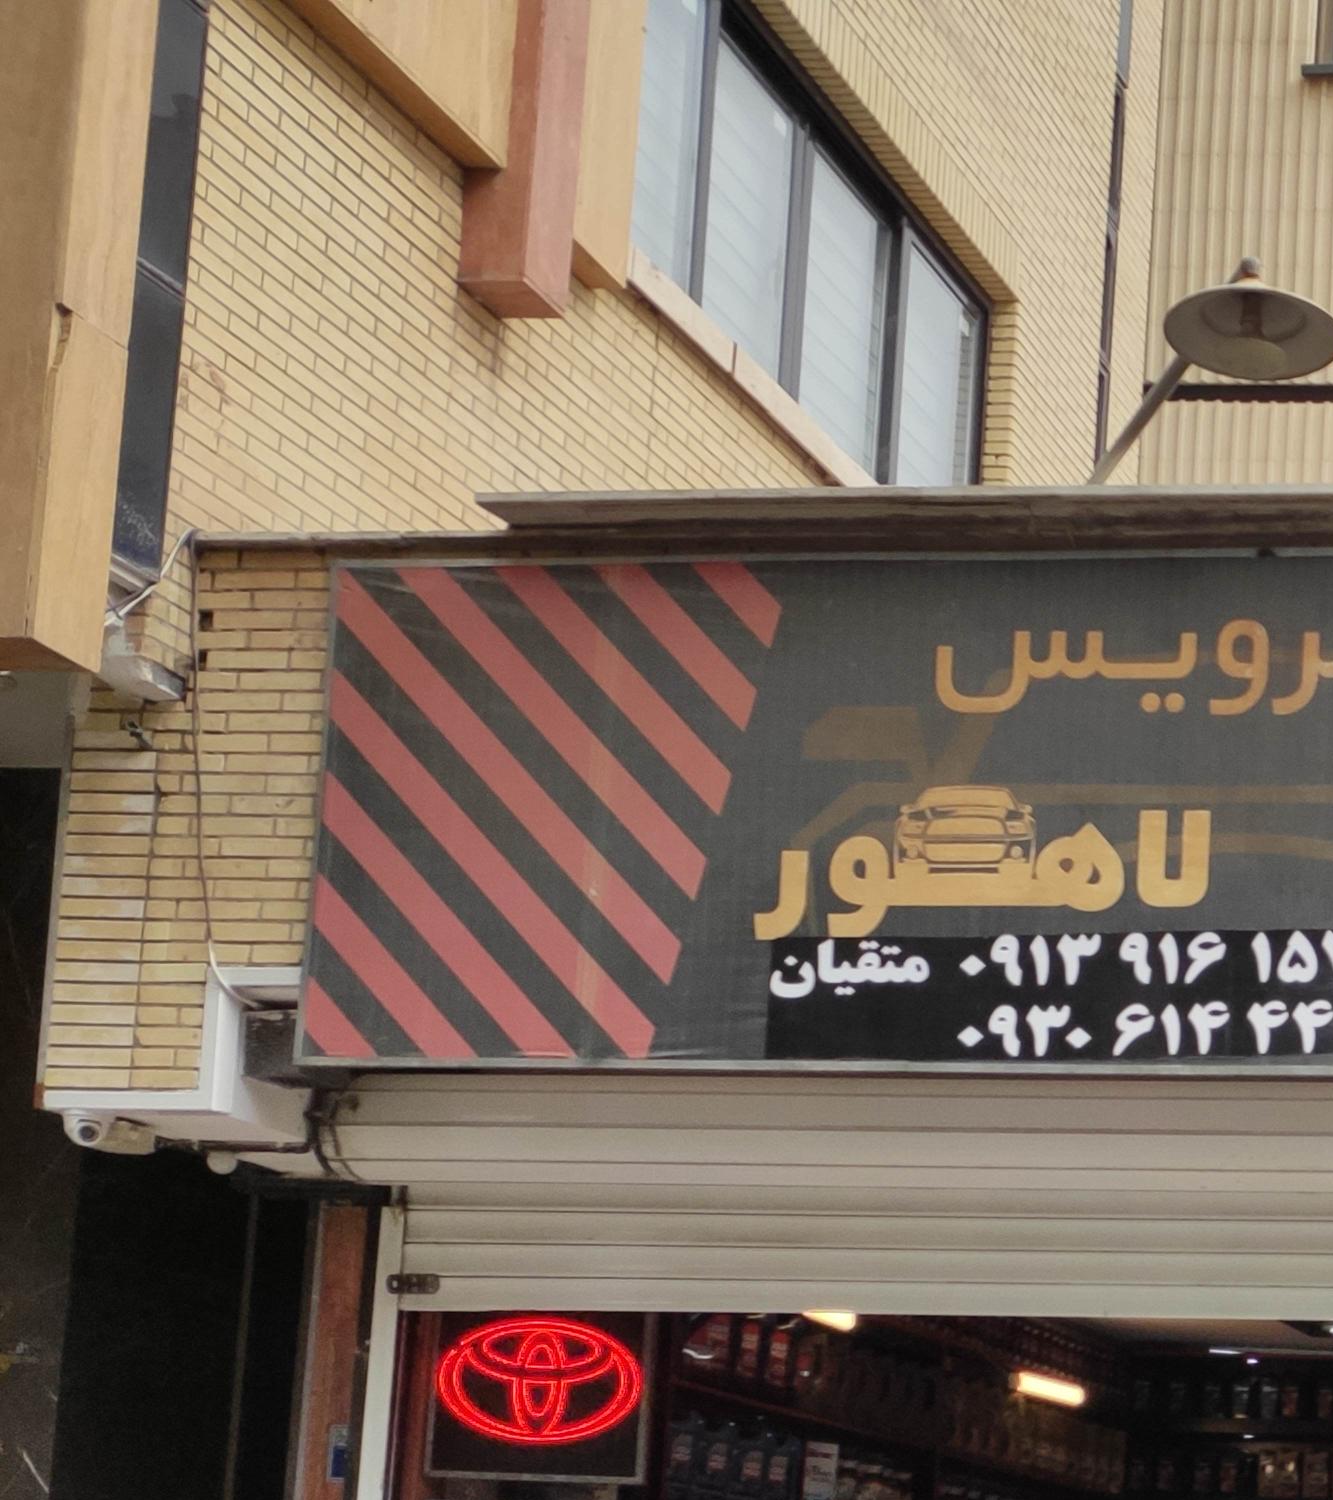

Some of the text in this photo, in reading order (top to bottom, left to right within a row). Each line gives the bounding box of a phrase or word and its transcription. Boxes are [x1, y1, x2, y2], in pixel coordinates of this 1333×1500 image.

[754, 809, 1211, 940] لاهور
[769, 940, 930, 997] متقیان
[959, 933, 1100, 987] ۰۹۱۳
[1119, 931, 1226, 985] ۹۱۶
[957, 1004, 1092, 1058] ۰۹۳۰
[1112, 1001, 1230, 1056] ۶۱۴
